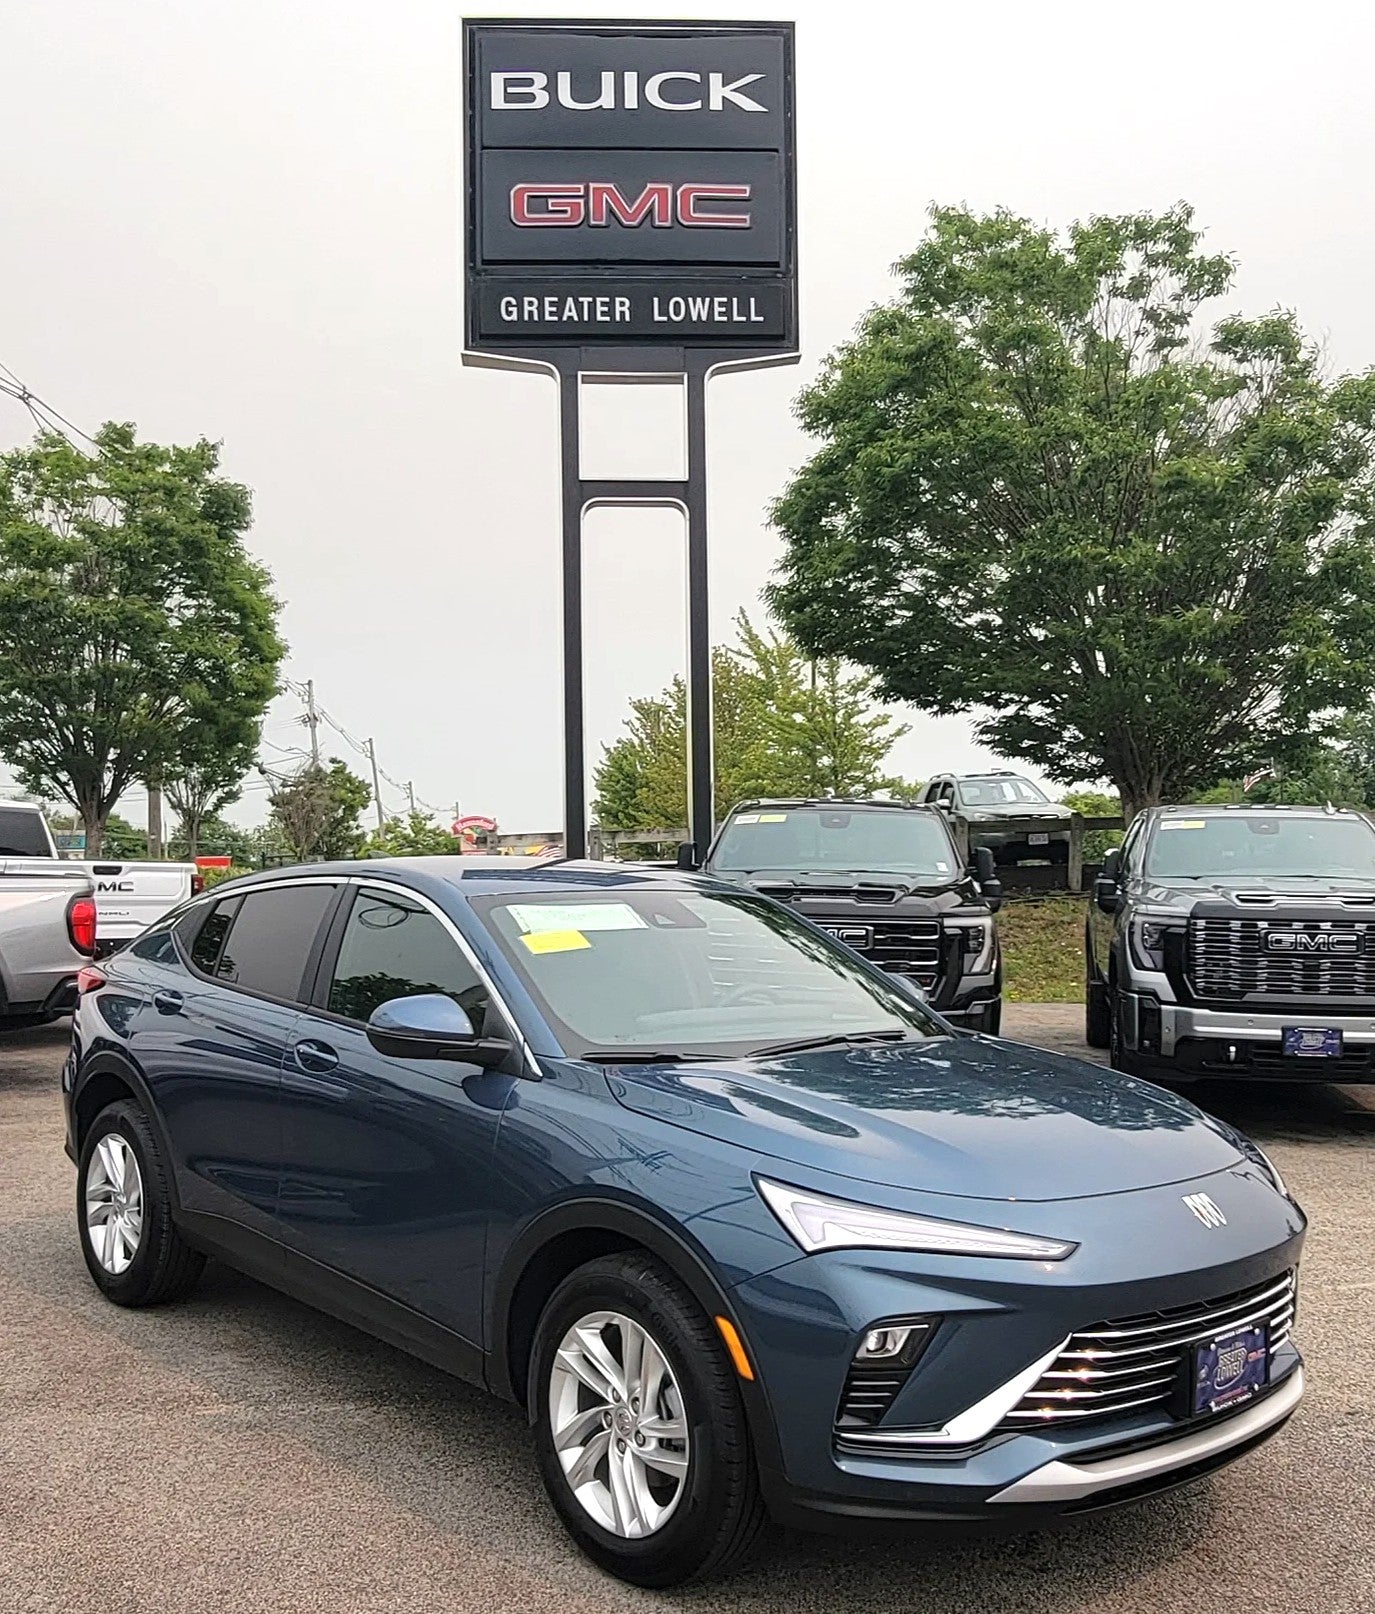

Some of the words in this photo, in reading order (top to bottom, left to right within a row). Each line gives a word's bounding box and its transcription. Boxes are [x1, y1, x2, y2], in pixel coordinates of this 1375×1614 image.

[490, 71, 769, 112] BUICK
[510, 182, 751, 229] GMC
[500, 297, 631, 322] GREATER
[653, 297, 764, 322] LOWELL
[97, 881, 134, 892] MC
[1268, 933, 1357, 951] GMC
